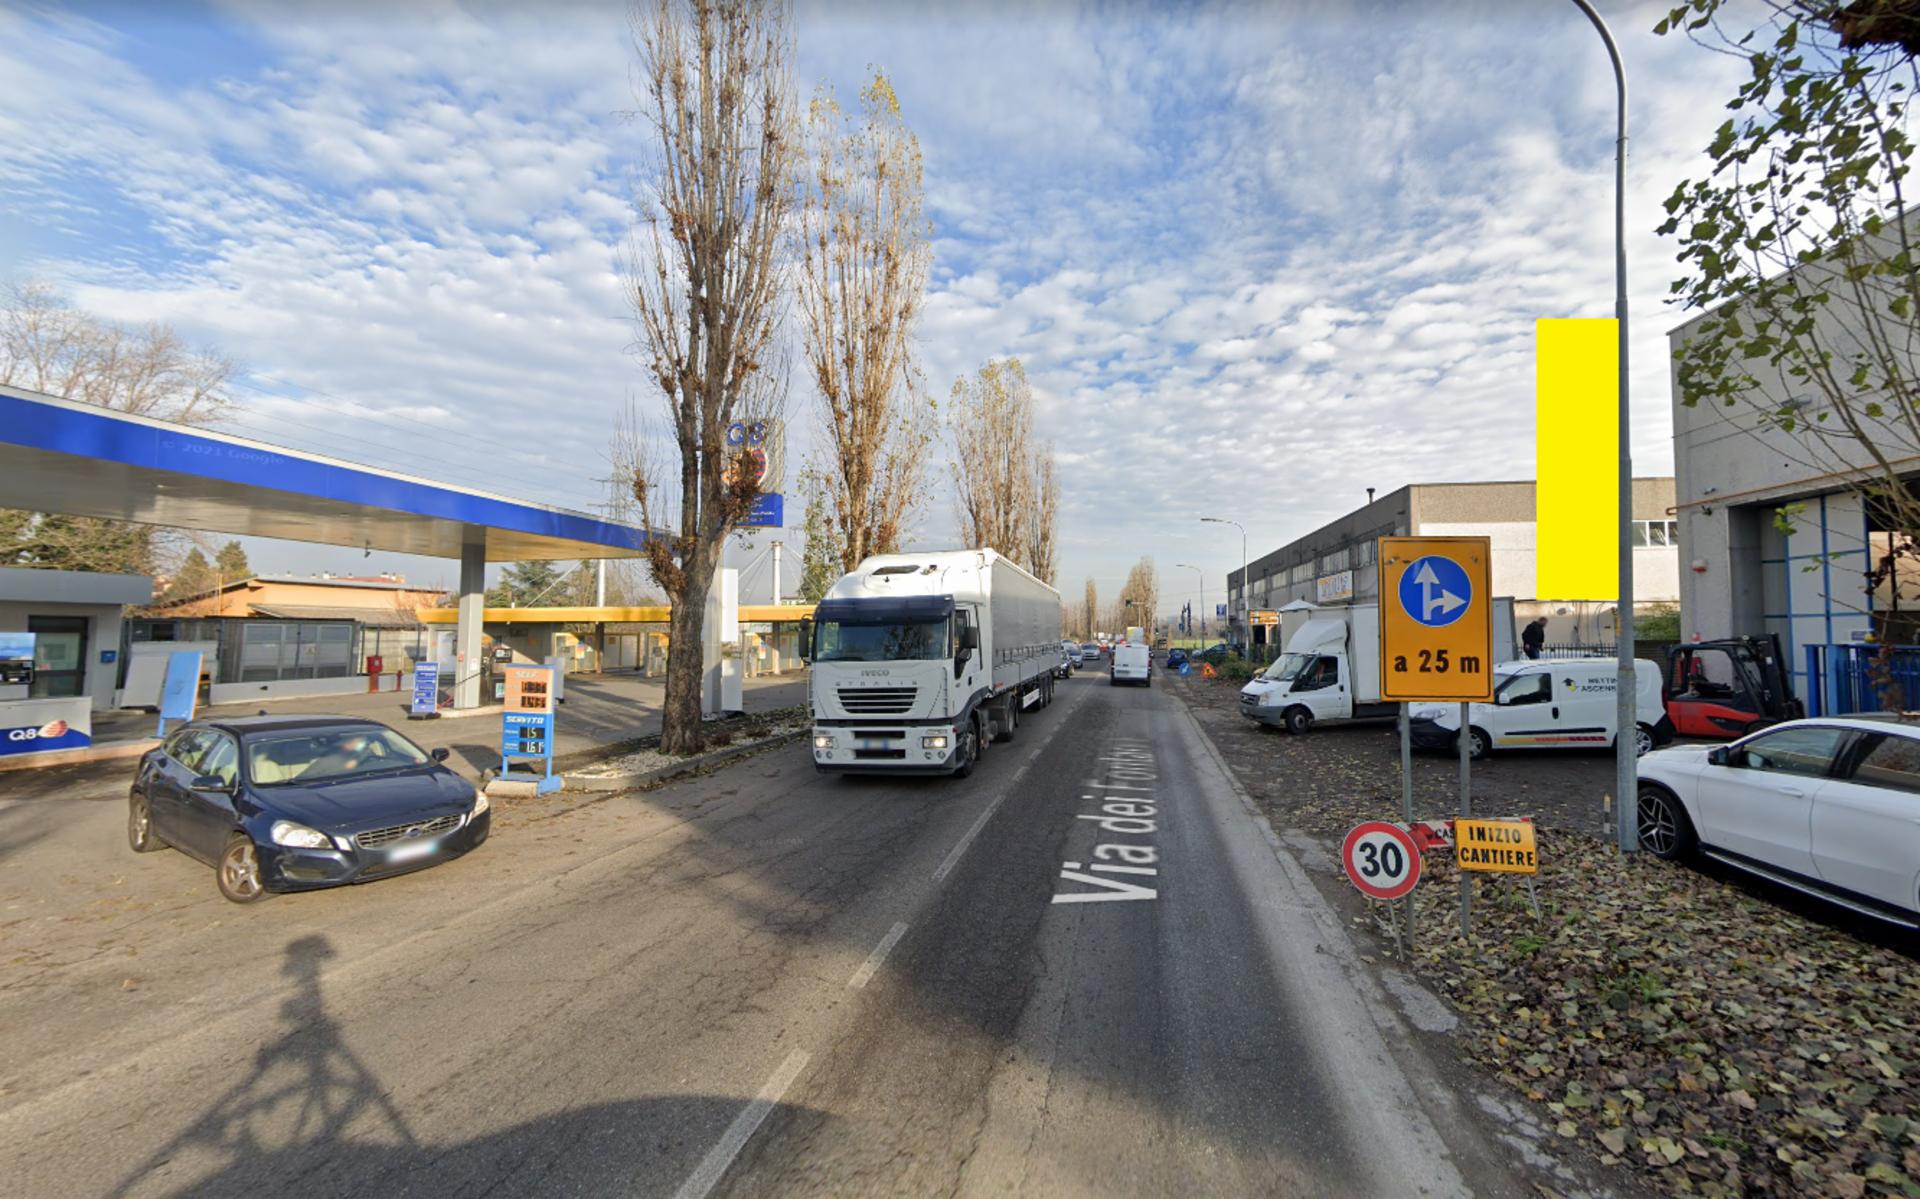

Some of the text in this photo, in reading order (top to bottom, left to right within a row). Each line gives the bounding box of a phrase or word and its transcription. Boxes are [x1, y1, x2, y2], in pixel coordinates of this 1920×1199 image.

[1394, 649, 1480, 673] a 25 m
[860, 669, 890, 677] IVECO
[505, 715, 545, 725] SERVITO
[9, 728, 37, 741] Q8
[1076, 795, 1158, 834] dei
[1469, 826, 1521, 843] INIZIO
[1359, 841, 1404, 879] 30
[1460, 847, 1534, 866] CANTIERE
[1051, 843, 1159, 904] Via
